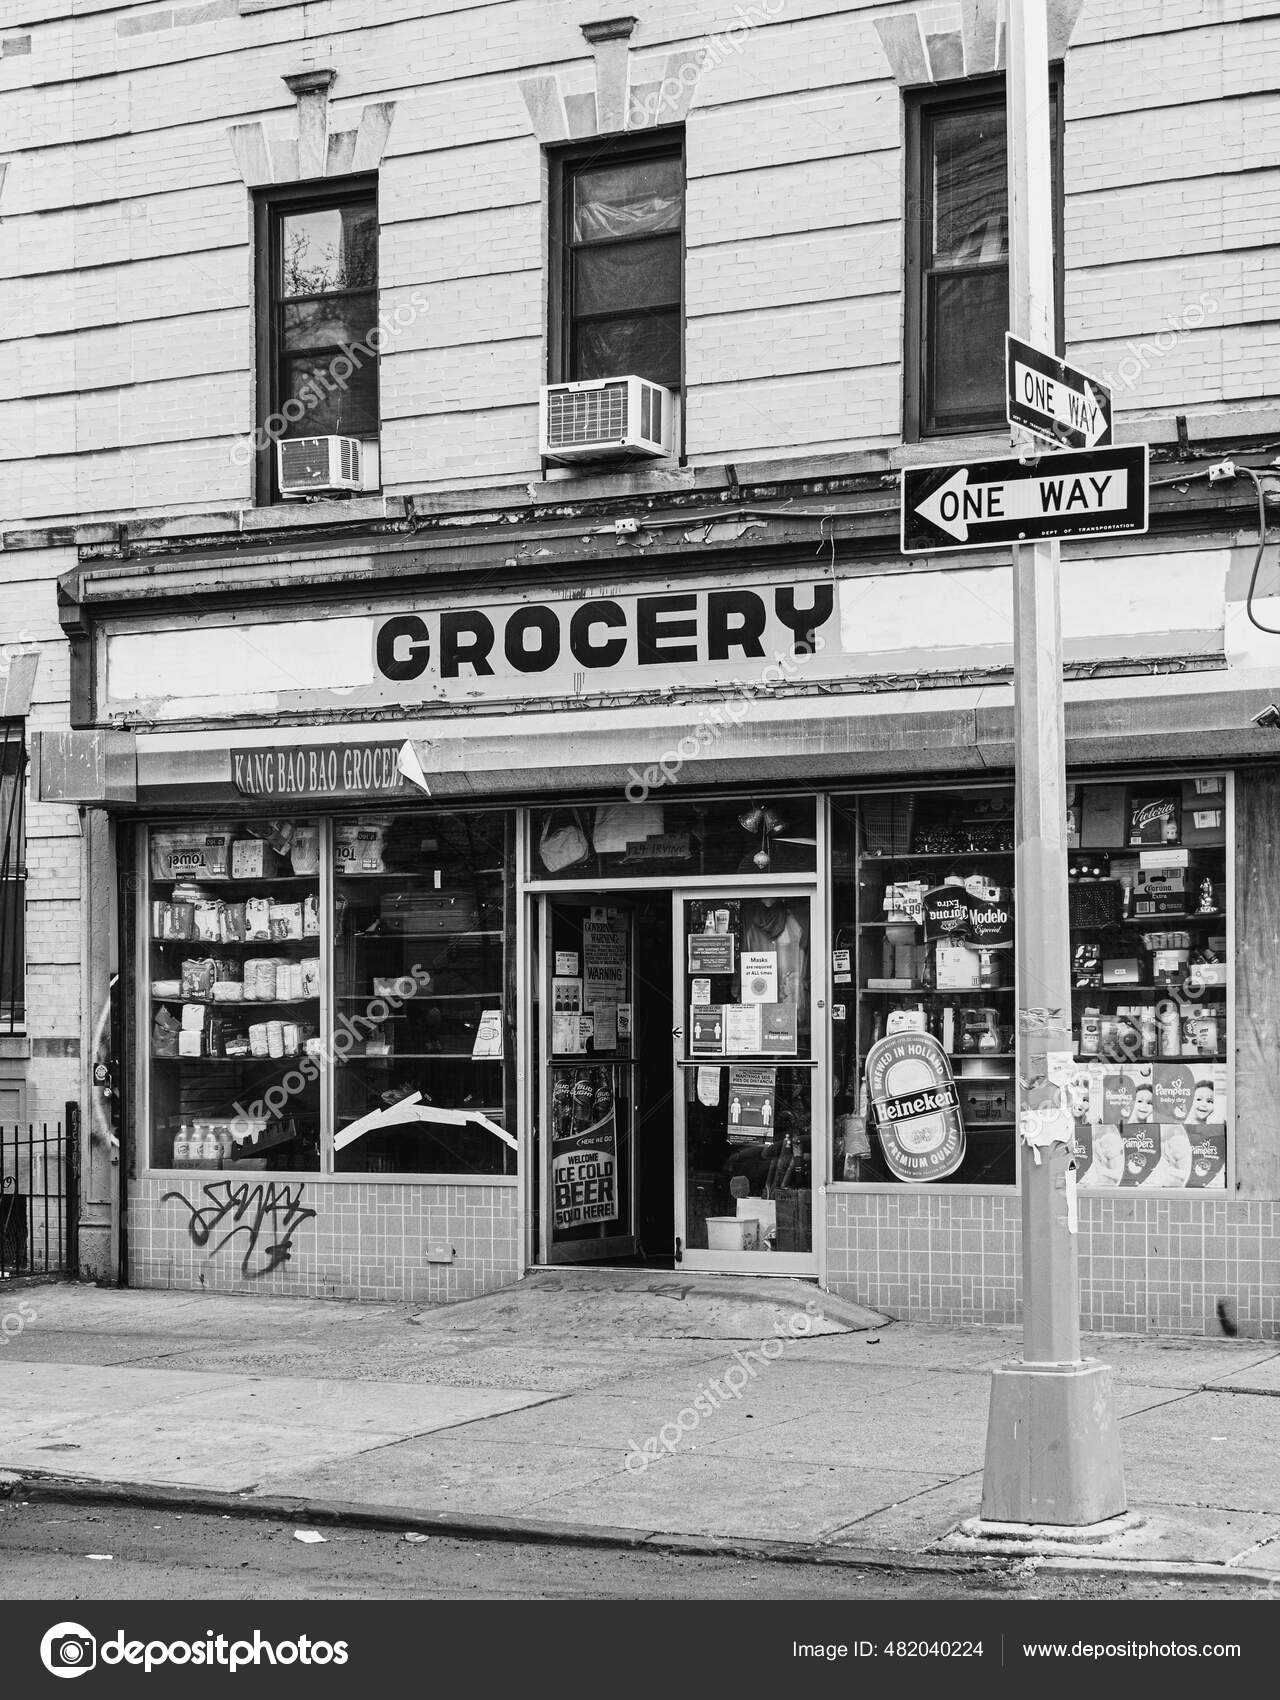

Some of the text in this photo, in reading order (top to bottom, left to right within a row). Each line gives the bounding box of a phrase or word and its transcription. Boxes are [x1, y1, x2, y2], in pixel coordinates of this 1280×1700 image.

[1024, 371, 1098, 435] ONE WAY
[940, 475, 1113, 522] ONE WAY
[1078, 523, 1135, 532] TRANSPORTATION
[376, 583, 834, 681] GROCERY
[234, 747, 404, 794] KANG BAO BAO GROCER
[1131, 800, 1176, 828] Victoria
[1144, 884, 1172, 894] Corona
[929, 905, 969, 920] Corona
[937, 899, 960, 909] Extra
[969, 908, 1008, 925] Modelo
[587, 967, 623, 981] WARNING
[873, 1052, 893, 1090] BREWED
[893, 1045, 905, 1058] IN
[908, 1044, 944, 1076] HOLLAND
[577, 1083, 593, 1092] BUD
[1155, 1084, 1191, 1097] Pampers
[875, 1090, 955, 1122] Heineken
[888, 1141, 929, 1169] PREMIUM
[930, 1127, 958, 1165] QUALITY
[1122, 1137, 1154, 1150] Pampers
[568, 1153, 599, 1165] WELCOME
[555, 1161, 613, 1184] ICE COLD
[555, 1177, 614, 1210] BEER
[583, 1203, 615, 1220] HERE!
